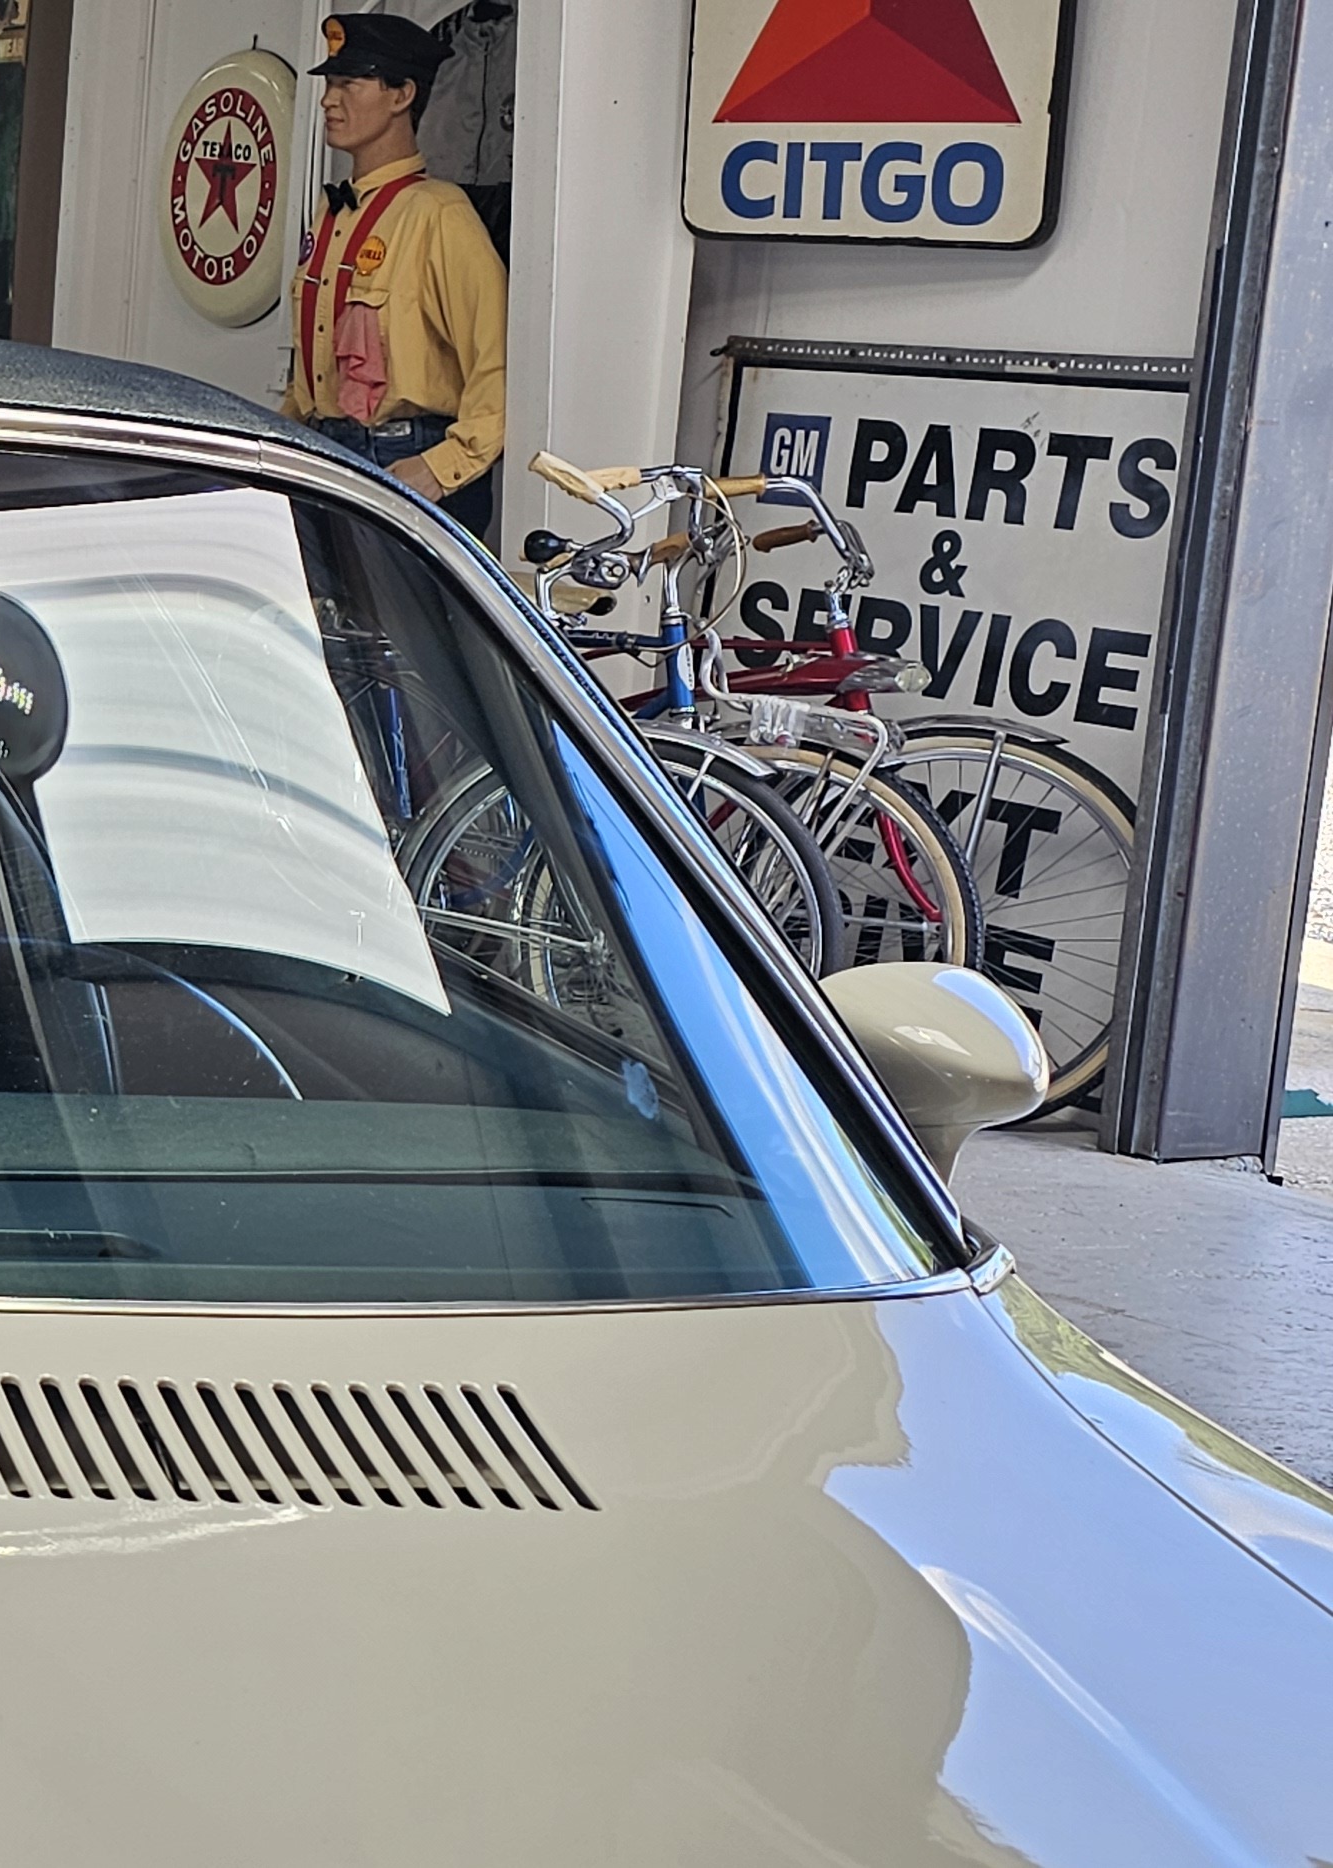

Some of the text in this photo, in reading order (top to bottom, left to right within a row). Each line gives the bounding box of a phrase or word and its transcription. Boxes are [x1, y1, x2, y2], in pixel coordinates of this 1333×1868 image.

[179, 91, 274, 167] GASOLINE
[202, 140, 252, 162] TEXCO
[720, 140, 1005, 227] CITGO
[173, 195, 271, 281] MOTOR OIL
[769, 427, 820, 477] GM
[845, 417, 1178, 540] PARTS
[918, 530, 966, 598] &
